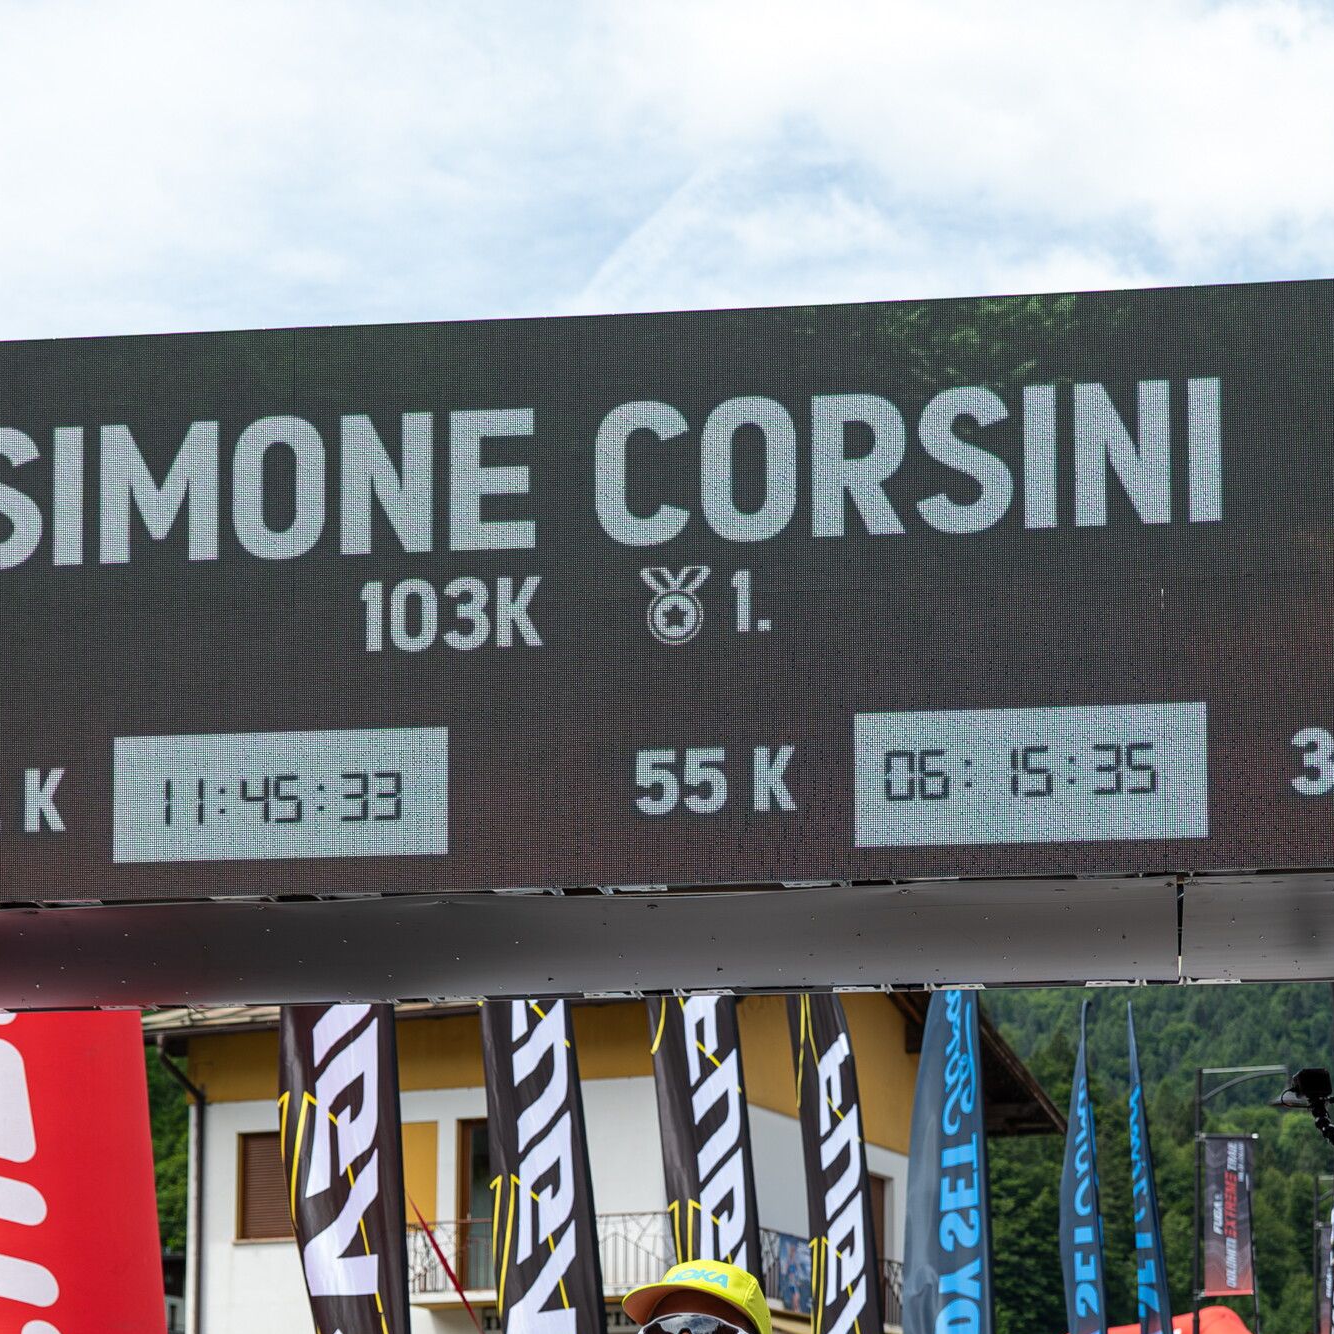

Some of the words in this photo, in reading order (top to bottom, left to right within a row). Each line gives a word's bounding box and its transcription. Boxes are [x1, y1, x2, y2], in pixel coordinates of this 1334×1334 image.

[594, 377, 1223, 547] CORSINI
[360, 576, 543, 652] 103K
[730, 569, 772, 632] 1.
[24, 767, 67, 833] K
[164, 771, 403, 826] 11:45:33
[634, 746, 728, 816] 55
[752, 744, 797, 813] K
[883, 742, 1158, 802] 06:15:35
